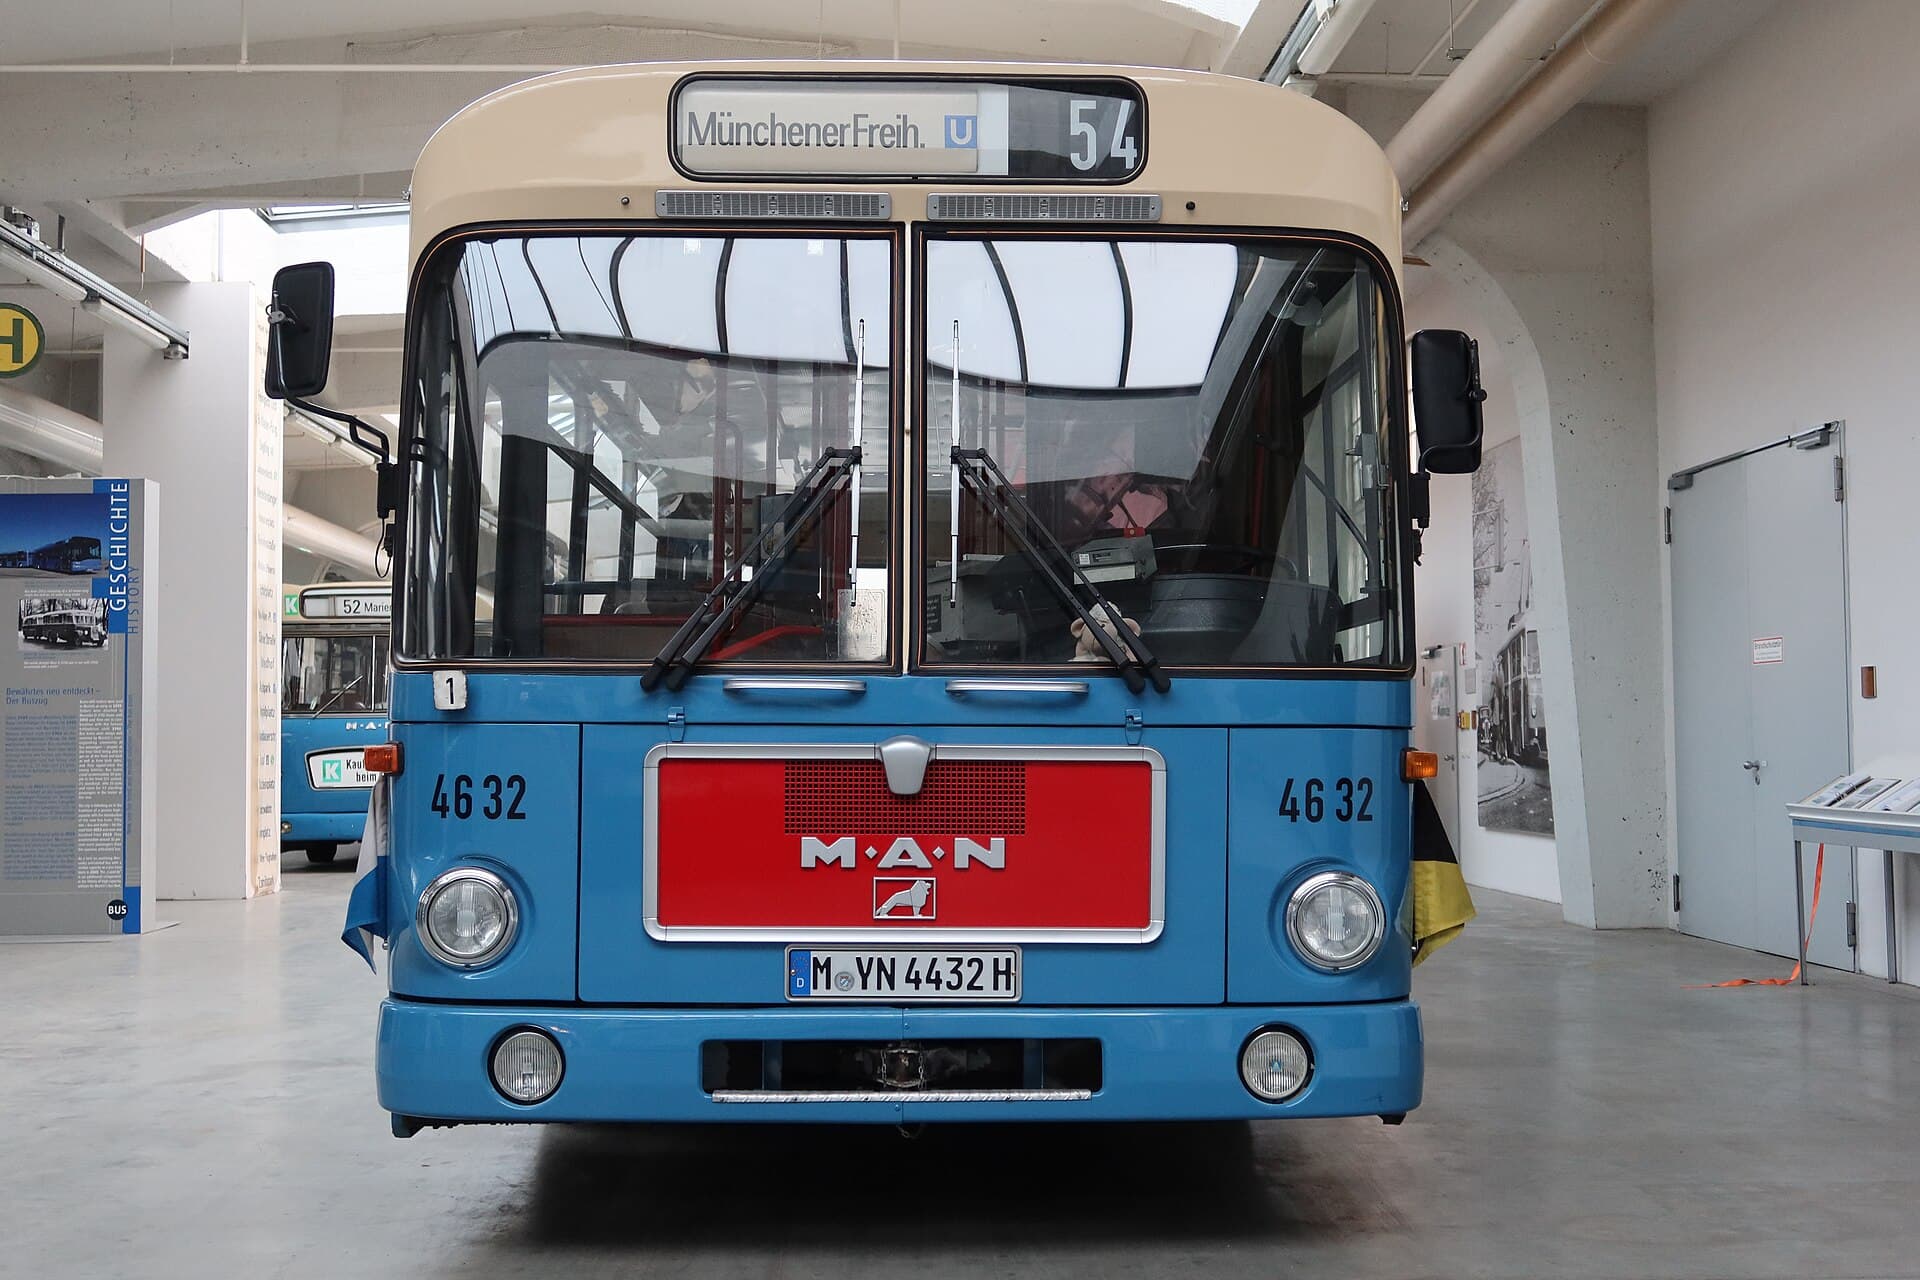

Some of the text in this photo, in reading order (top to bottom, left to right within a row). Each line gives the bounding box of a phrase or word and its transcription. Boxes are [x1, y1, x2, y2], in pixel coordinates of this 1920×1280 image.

[853, 113, 925, 149] Freih.
[0, 318, 24, 364] H
[110, 483, 128, 611] GESCHICHTE
[128, 566, 140, 634] HISTORY
[343, 600, 391, 614] 52 Marie
[446, 677, 454, 704] 1
[356, 772, 377, 782] heim
[108, 905, 127, 915] BUS
[796, 978, 805, 988] D
[812, 956, 832, 990] M
[855, 956, 896, 991] YN
